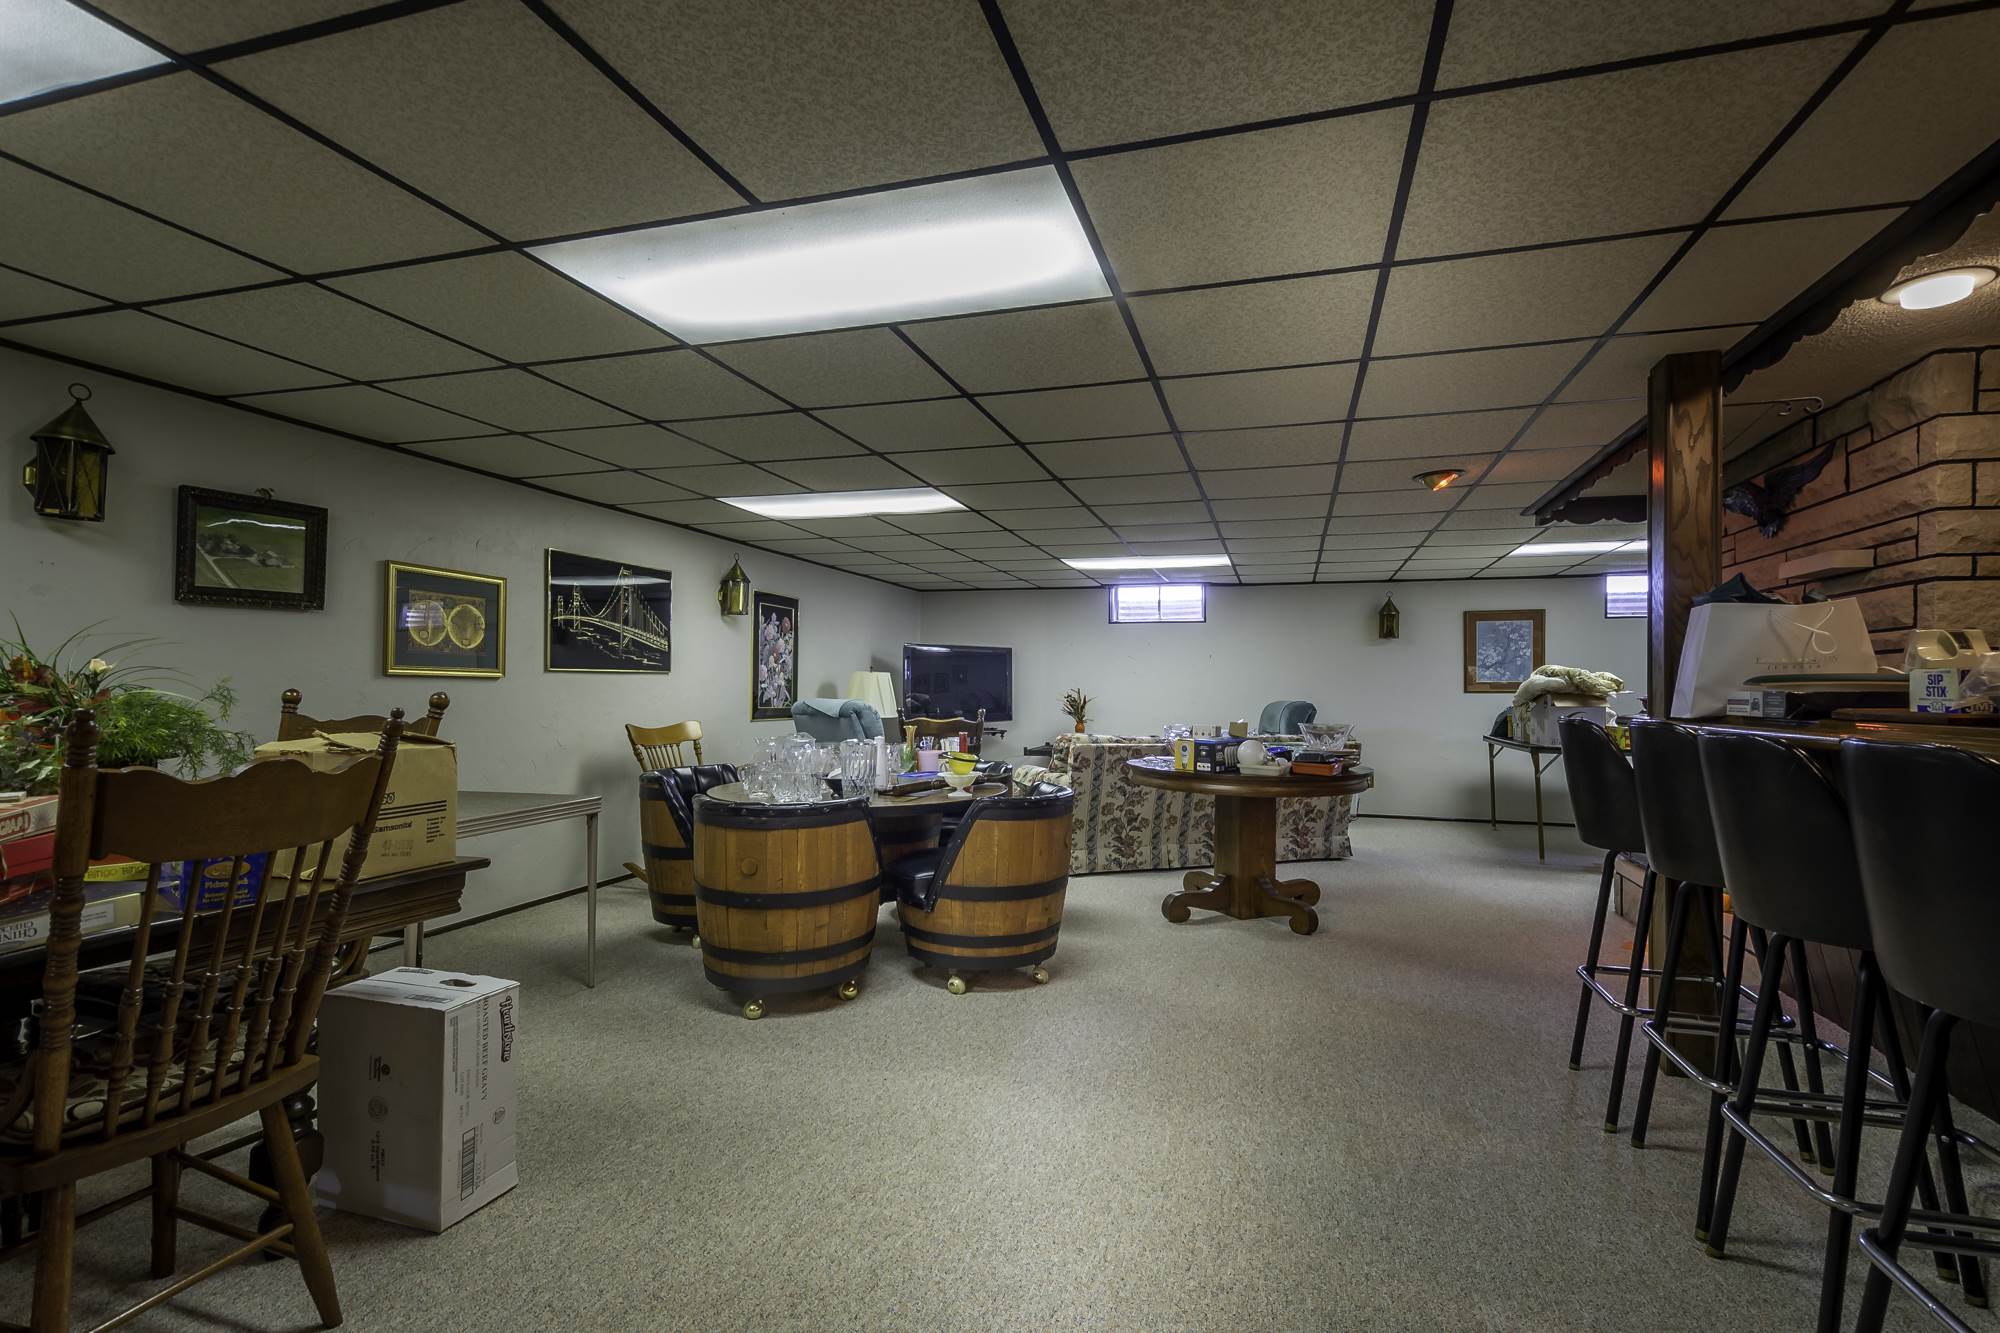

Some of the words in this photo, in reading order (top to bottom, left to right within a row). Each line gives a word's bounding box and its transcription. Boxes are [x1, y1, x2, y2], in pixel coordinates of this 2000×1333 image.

[1927, 674, 1944, 685] SIP
[1926, 686, 1948, 697] STIX
[500, 995, 515, 1062] Hearthstone
